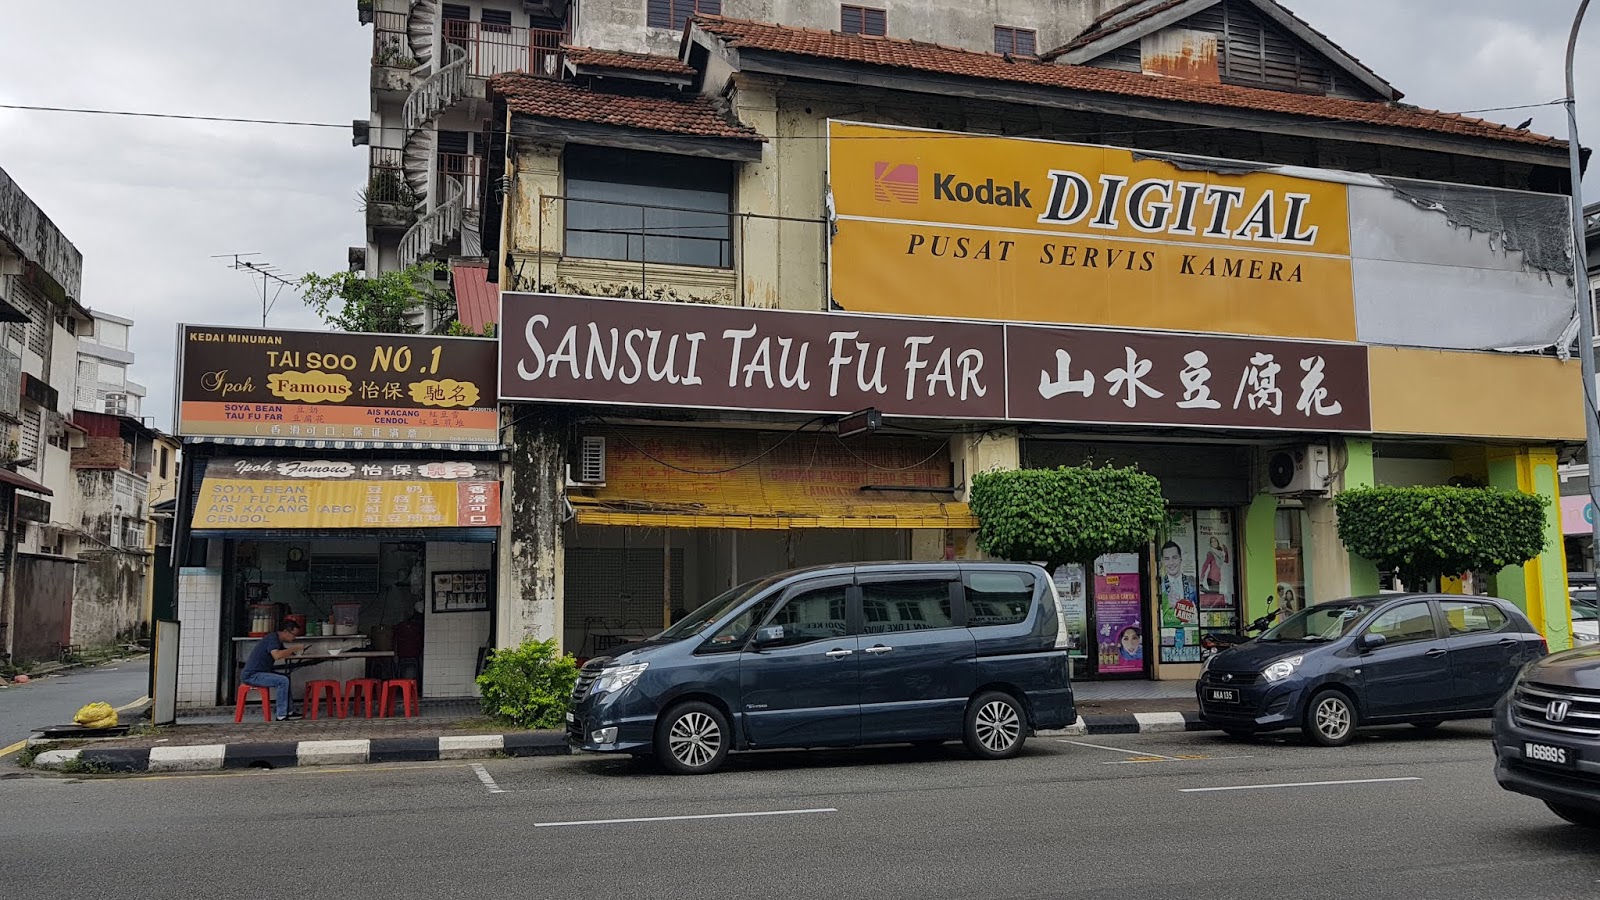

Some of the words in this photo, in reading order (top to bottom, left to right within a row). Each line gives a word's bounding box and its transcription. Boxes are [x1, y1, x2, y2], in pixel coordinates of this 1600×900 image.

[933, 174, 1032, 209] Kodak
[1039, 169, 1320, 245] DIGITAL
[905, 233, 1015, 263] PUSAT
[1039, 243, 1156, 272] SERVIS
[1179, 254, 1304, 284] KAMERA
[190, 333, 224, 342] KEDAI
[228, 335, 282, 345] MINUMAN
[266, 351, 300, 368] TAI
[306, 353, 357, 370] SOO
[517, 314, 706, 387] SANSUI
[723, 323, 811, 392] TAU
[828, 330, 888, 398] FU
[903, 334, 987, 401] FAR
[200, 369, 256, 397] Ipoh
[276, 379, 347, 396] Famous
[1039, 345, 1343, 419] 山水豆腐花
[224, 404, 251, 412] SOYA
[255, 405, 282, 414] BEAN
[366, 409, 381, 417] AIS
[384, 410, 420, 418] KACANG
[225, 412, 246, 420] TAU
[248, 413, 262, 421] FU
[264, 413, 283, 421] FAR
[374, 417, 409, 425] CENDOL
[234, 459, 273, 474] Ipoh
[285, 462, 349, 474] Famous
[212, 484, 258, 494] SOYA
[263, 484, 305, 494] BEAN
[211, 495, 247, 504] TAU
[250, 495, 275, 504] FU
[277, 495, 308, 504] FAR
[208, 504, 239, 513] AIS
[243, 504, 310, 514] KACANG
[316, 504, 357, 514] (ABC)
[206, 514, 271, 523] CENDOL
